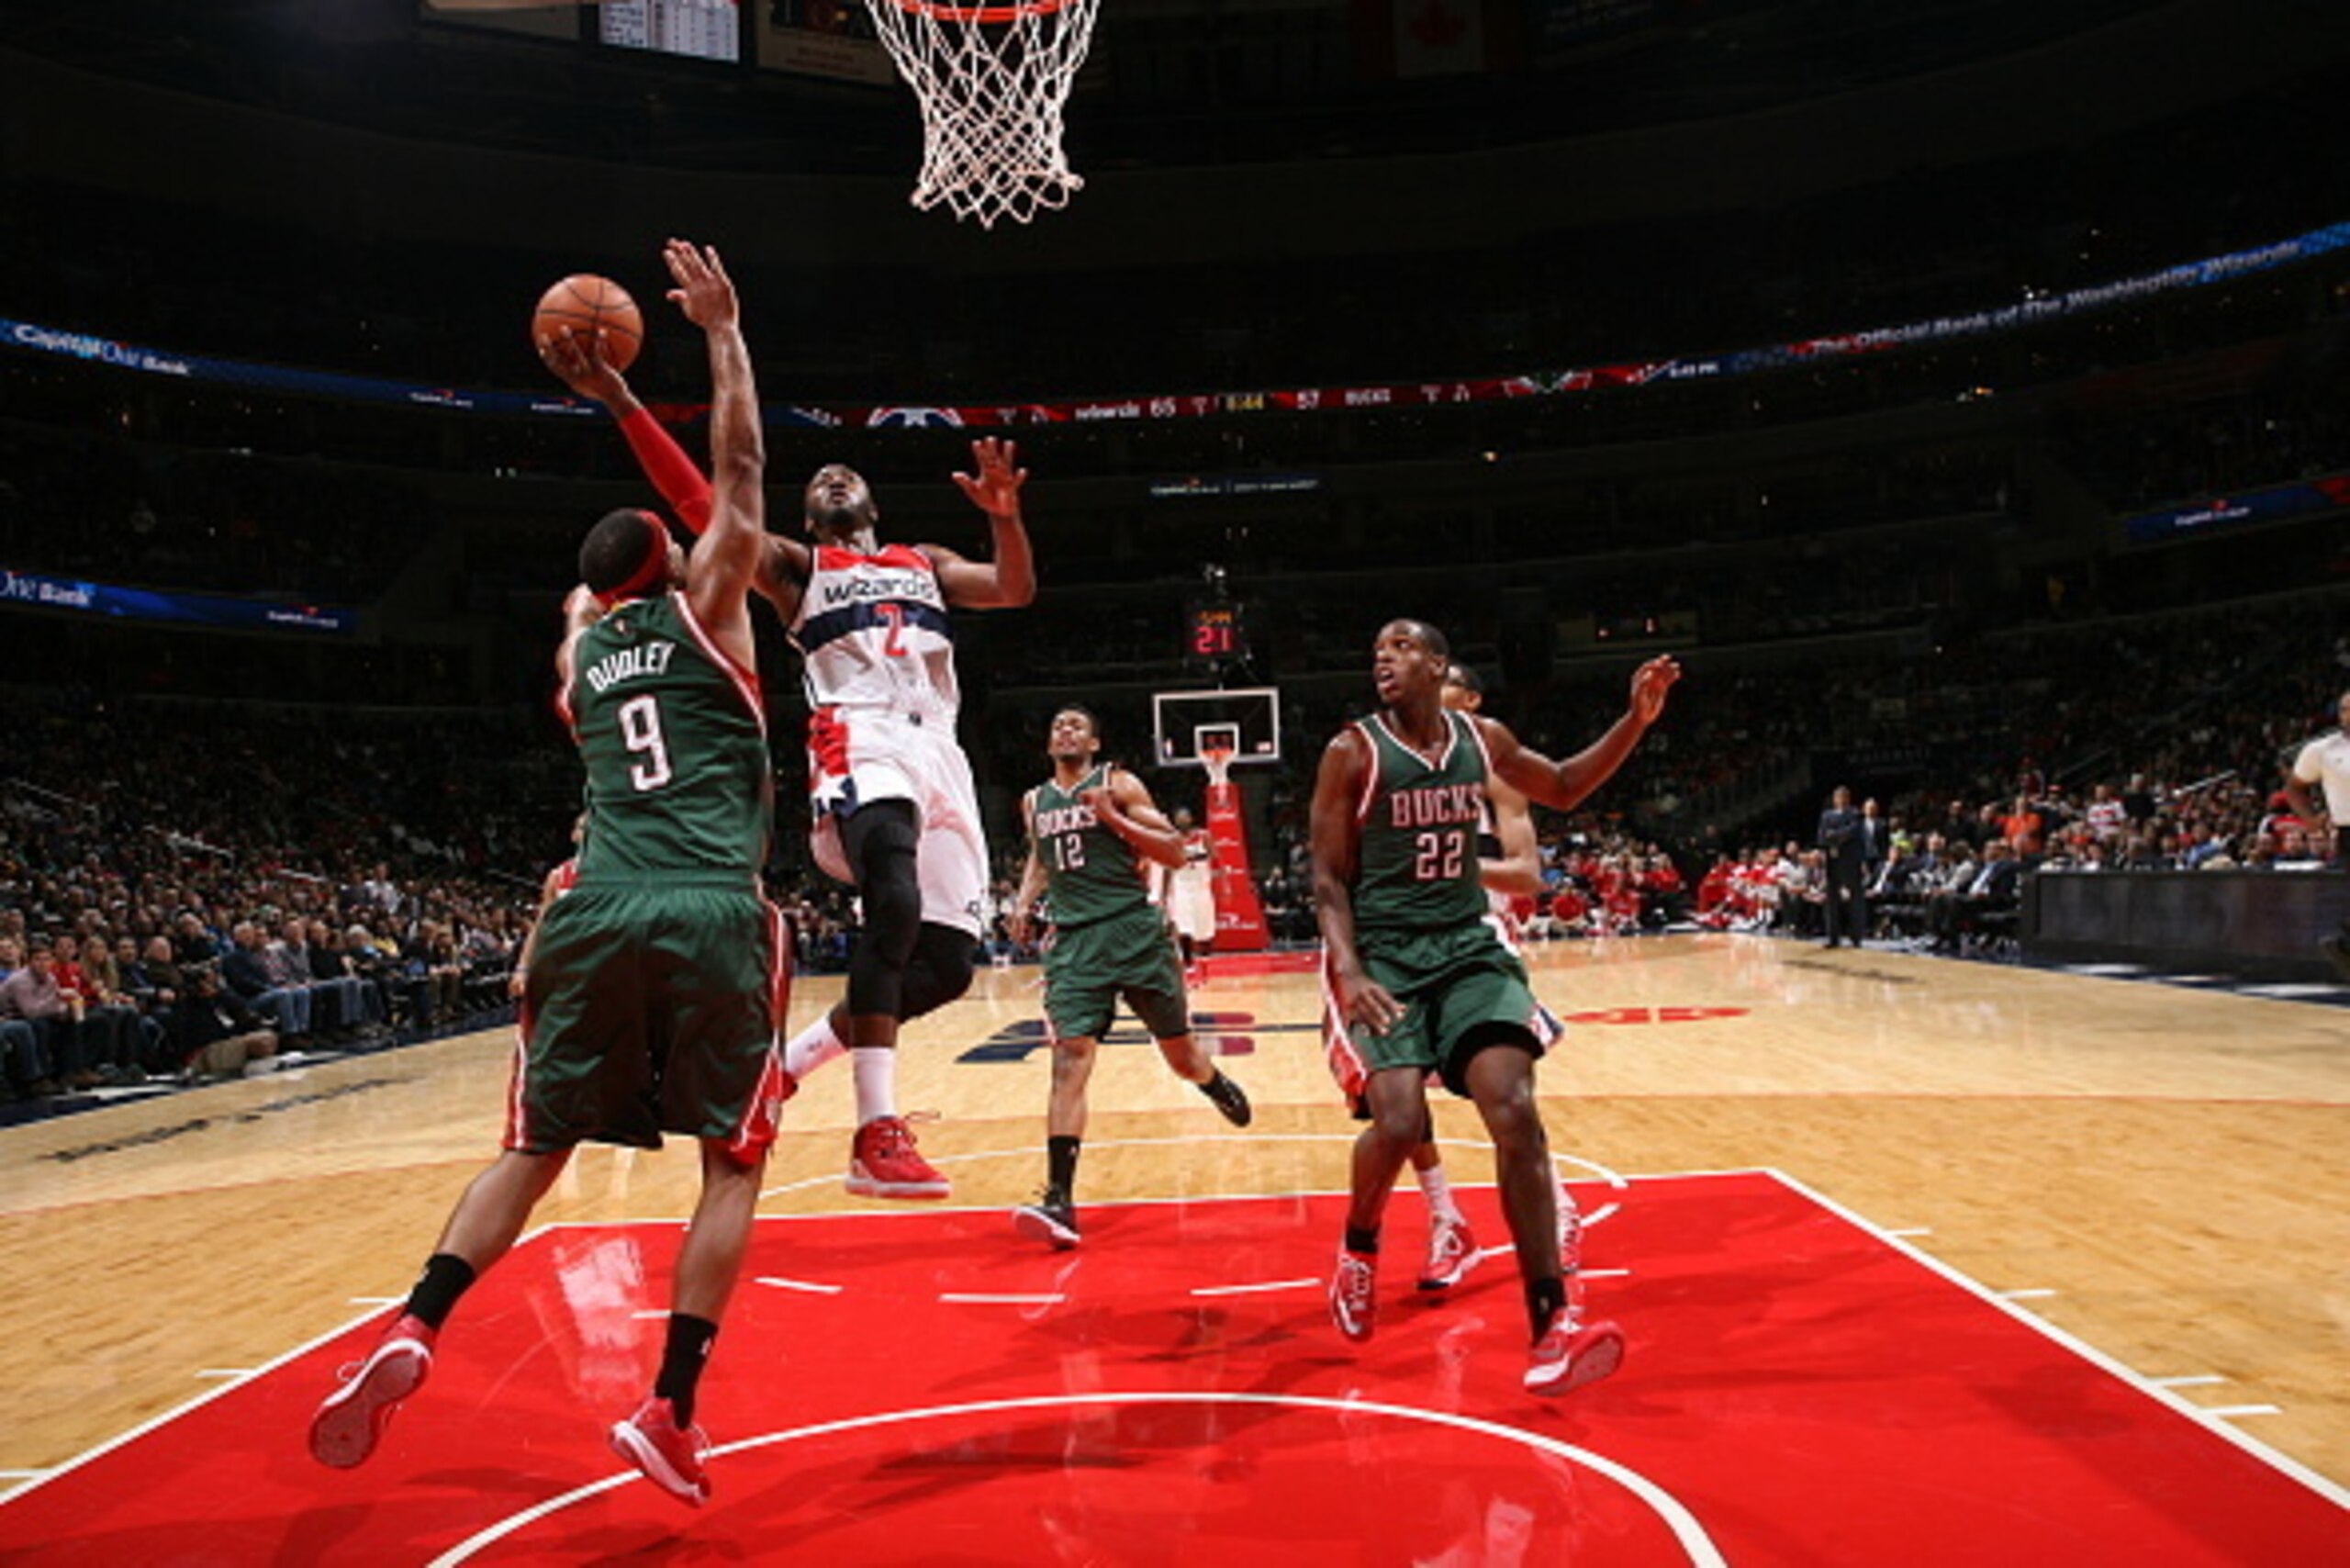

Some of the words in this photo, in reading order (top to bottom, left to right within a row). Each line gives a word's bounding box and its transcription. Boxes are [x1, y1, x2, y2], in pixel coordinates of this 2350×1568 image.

[1856, 323, 1930, 345] Official
[1935, 313, 1991, 335] Bank
[1995, 305, 2019, 323] of
[2065, 265, 2199, 313] Washington
[2203, 239, 2301, 275] Wizards
[142, 355, 190, 375] Bank
[1149, 396, 1177, 418] 65
[39, 582, 90, 607] Bank
[874, 601, 910, 657] 2
[1195, 625, 1230, 654] 21
[586, 642, 676, 693] DUDLEY
[617, 692, 673, 792] 9
[1035, 804, 1098, 839] BUCKS
[1391, 782, 1483, 828] BUCKS
[1054, 833, 1085, 871] 12
[1416, 829, 1465, 880] 22
